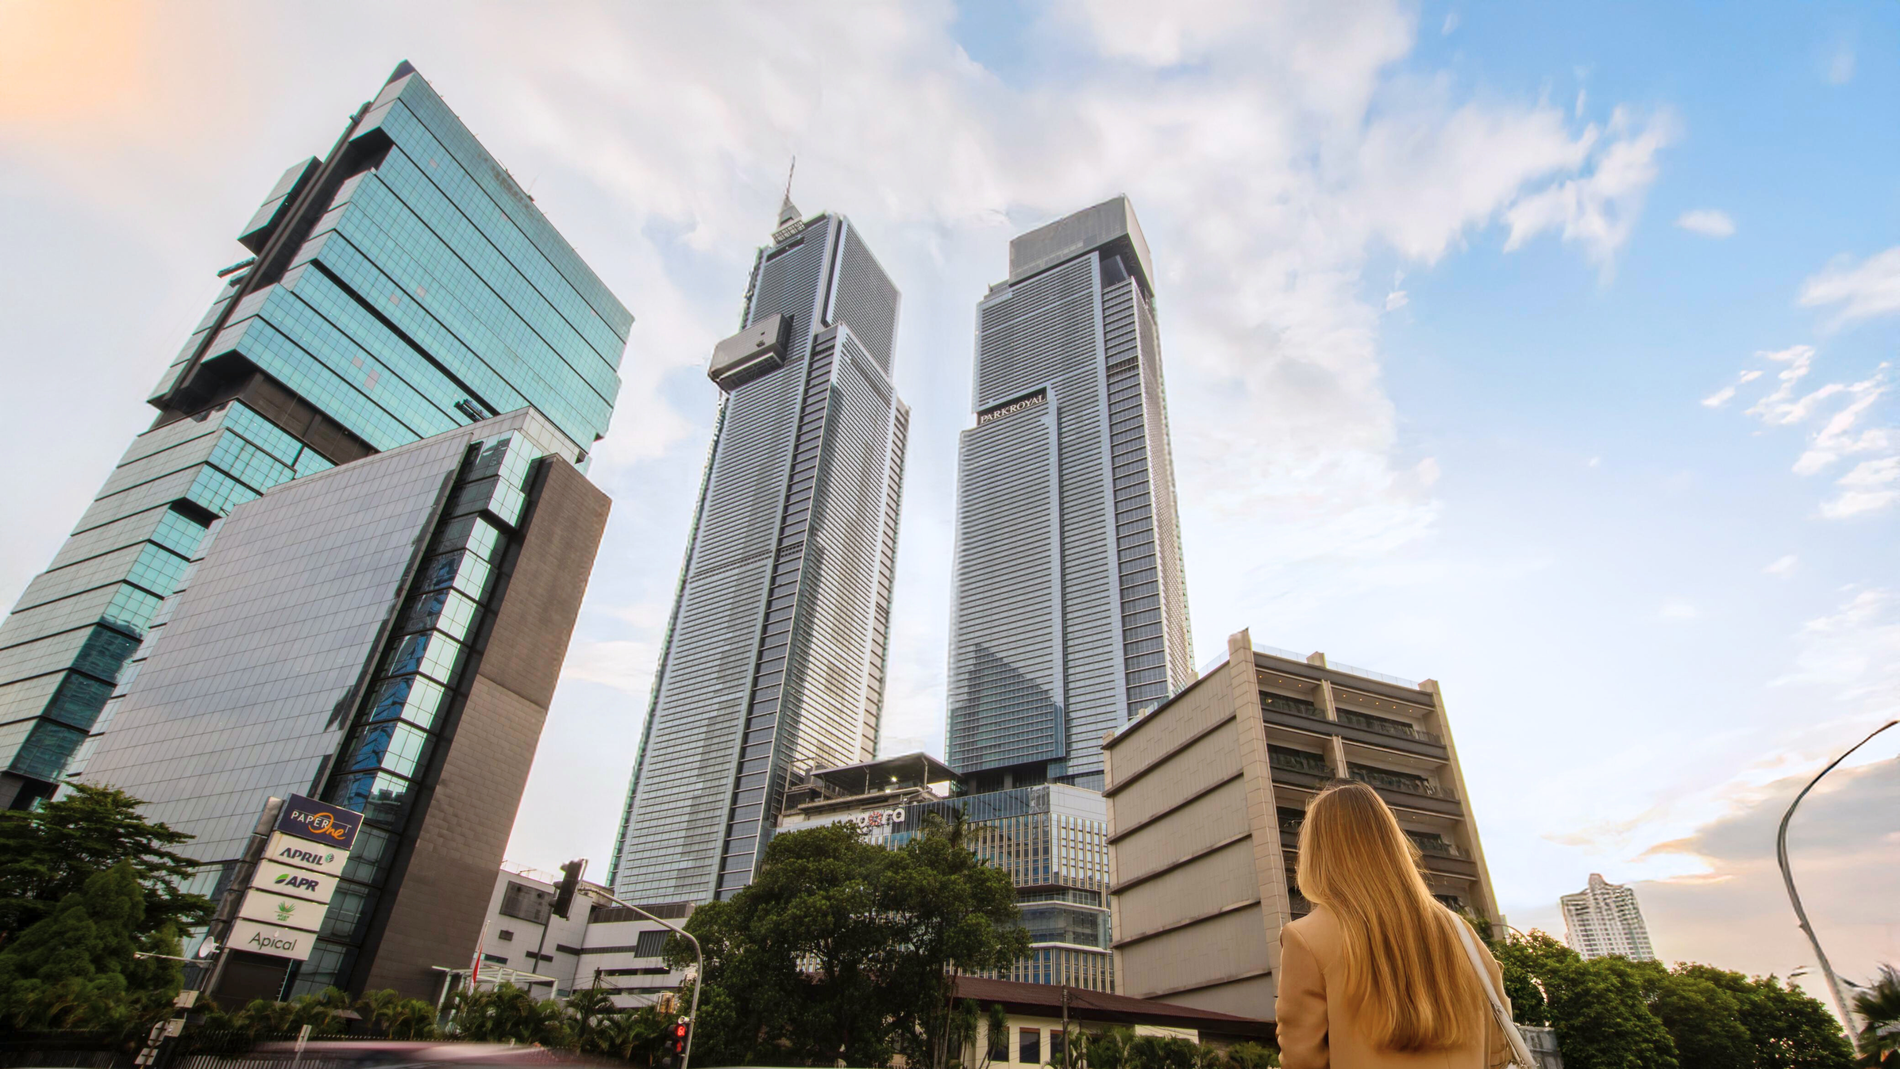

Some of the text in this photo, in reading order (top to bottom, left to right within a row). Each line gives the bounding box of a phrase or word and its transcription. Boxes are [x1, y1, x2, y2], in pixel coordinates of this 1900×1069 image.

[980, 394, 1047, 424] PARKROYAL
[291, 810, 347, 840] PAPER One
[279, 847, 324, 866] APRIL
[285, 875, 320, 892] APR
[248, 931, 298, 951] Apical
